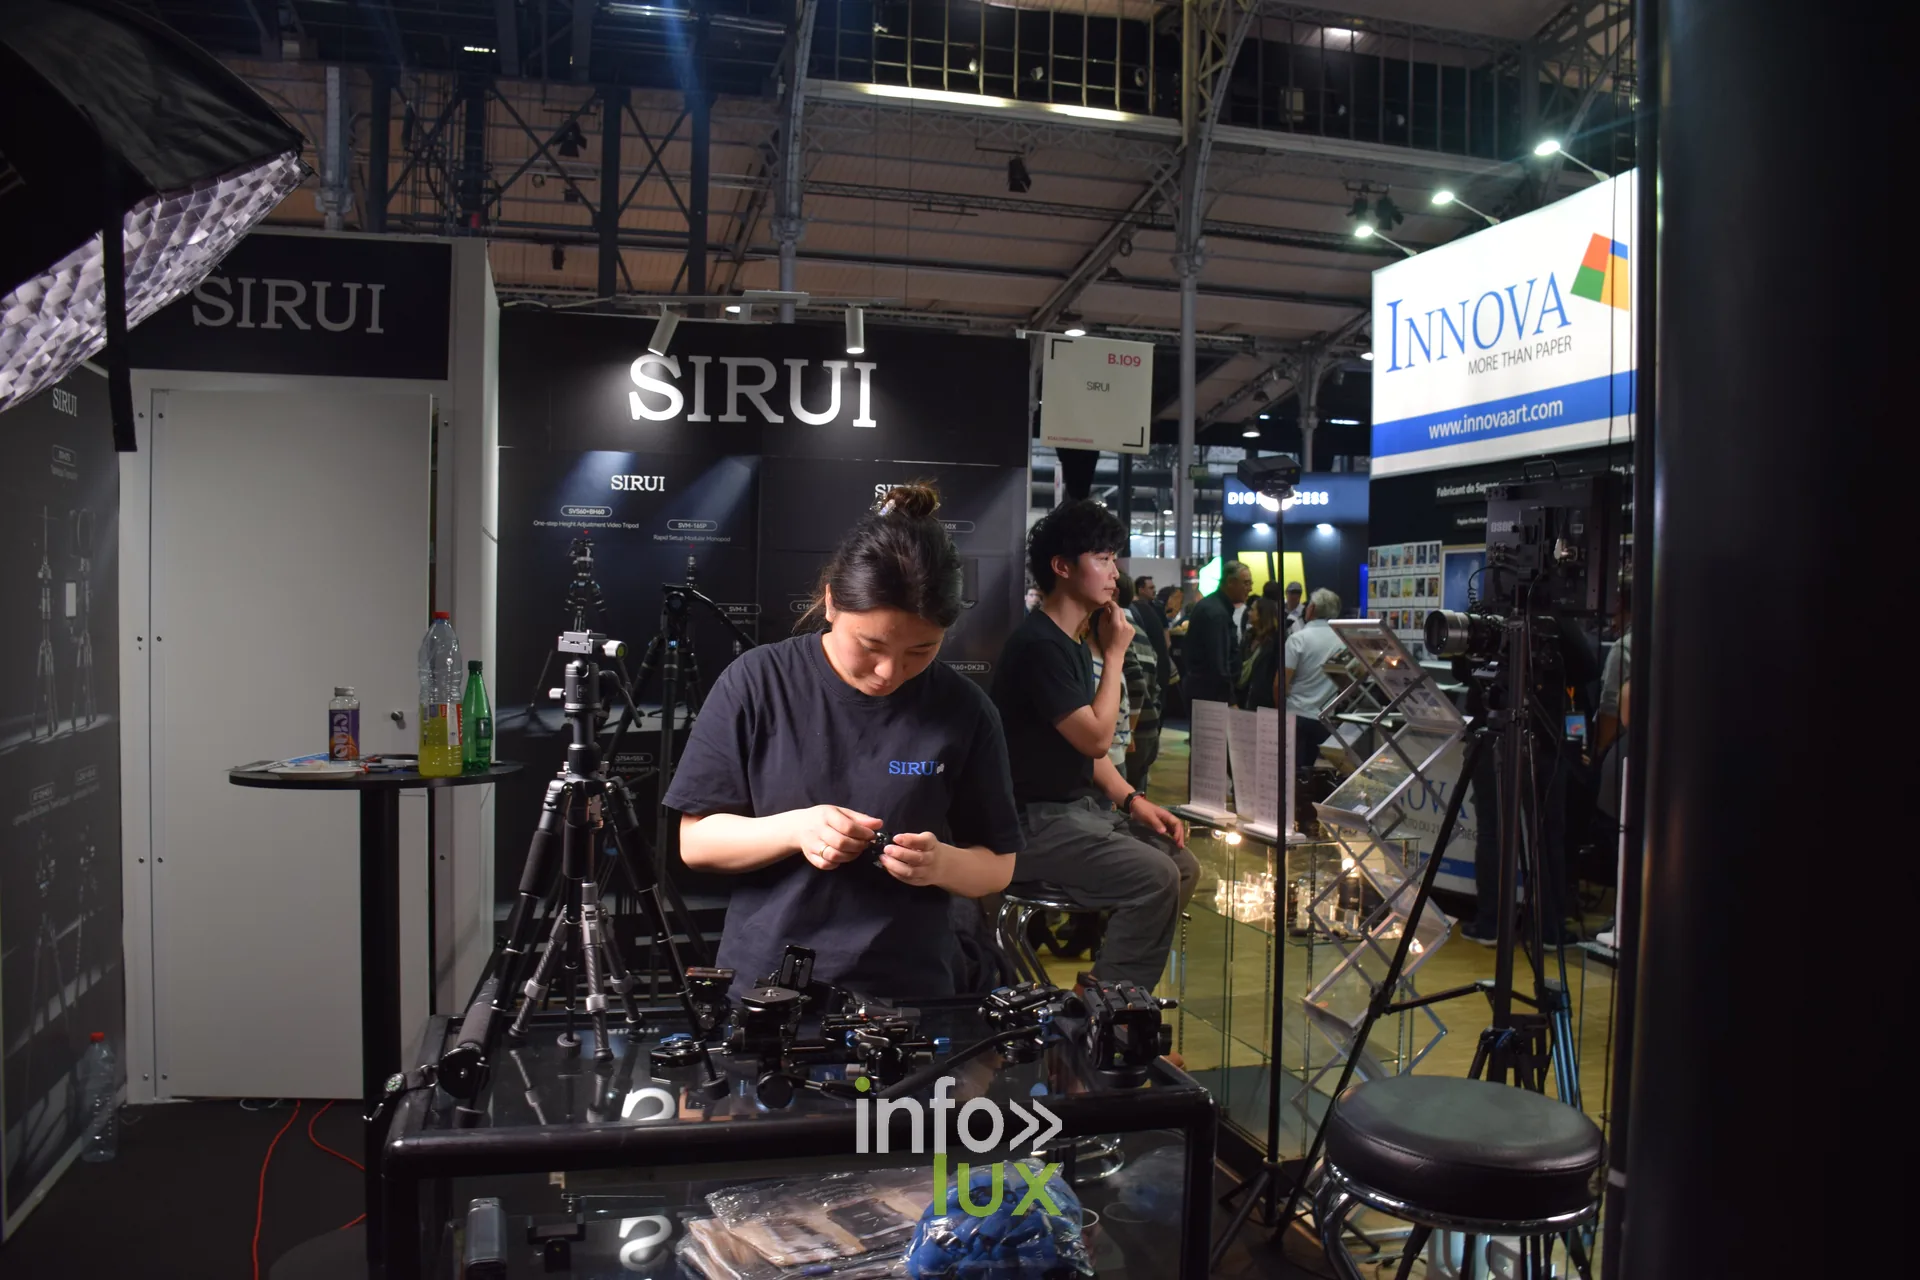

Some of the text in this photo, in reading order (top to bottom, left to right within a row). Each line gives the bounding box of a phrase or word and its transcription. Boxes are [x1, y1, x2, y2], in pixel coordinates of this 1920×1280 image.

[192, 276, 386, 334] SIRUI
[1107, 353, 1141, 367] B.109
[1468, 335, 1573, 376] MORE THAN PAPER
[628, 354, 877, 428] SIRUI
[1086, 381, 1110, 392] SIRUI
[53, 387, 77, 418] SIRUI
[1429, 399, 1563, 440] www.innovaart.com
[610, 474, 666, 492] SIRUI
[559, 521, 576, 529] Height
[622, 522, 639, 530] Tripod
